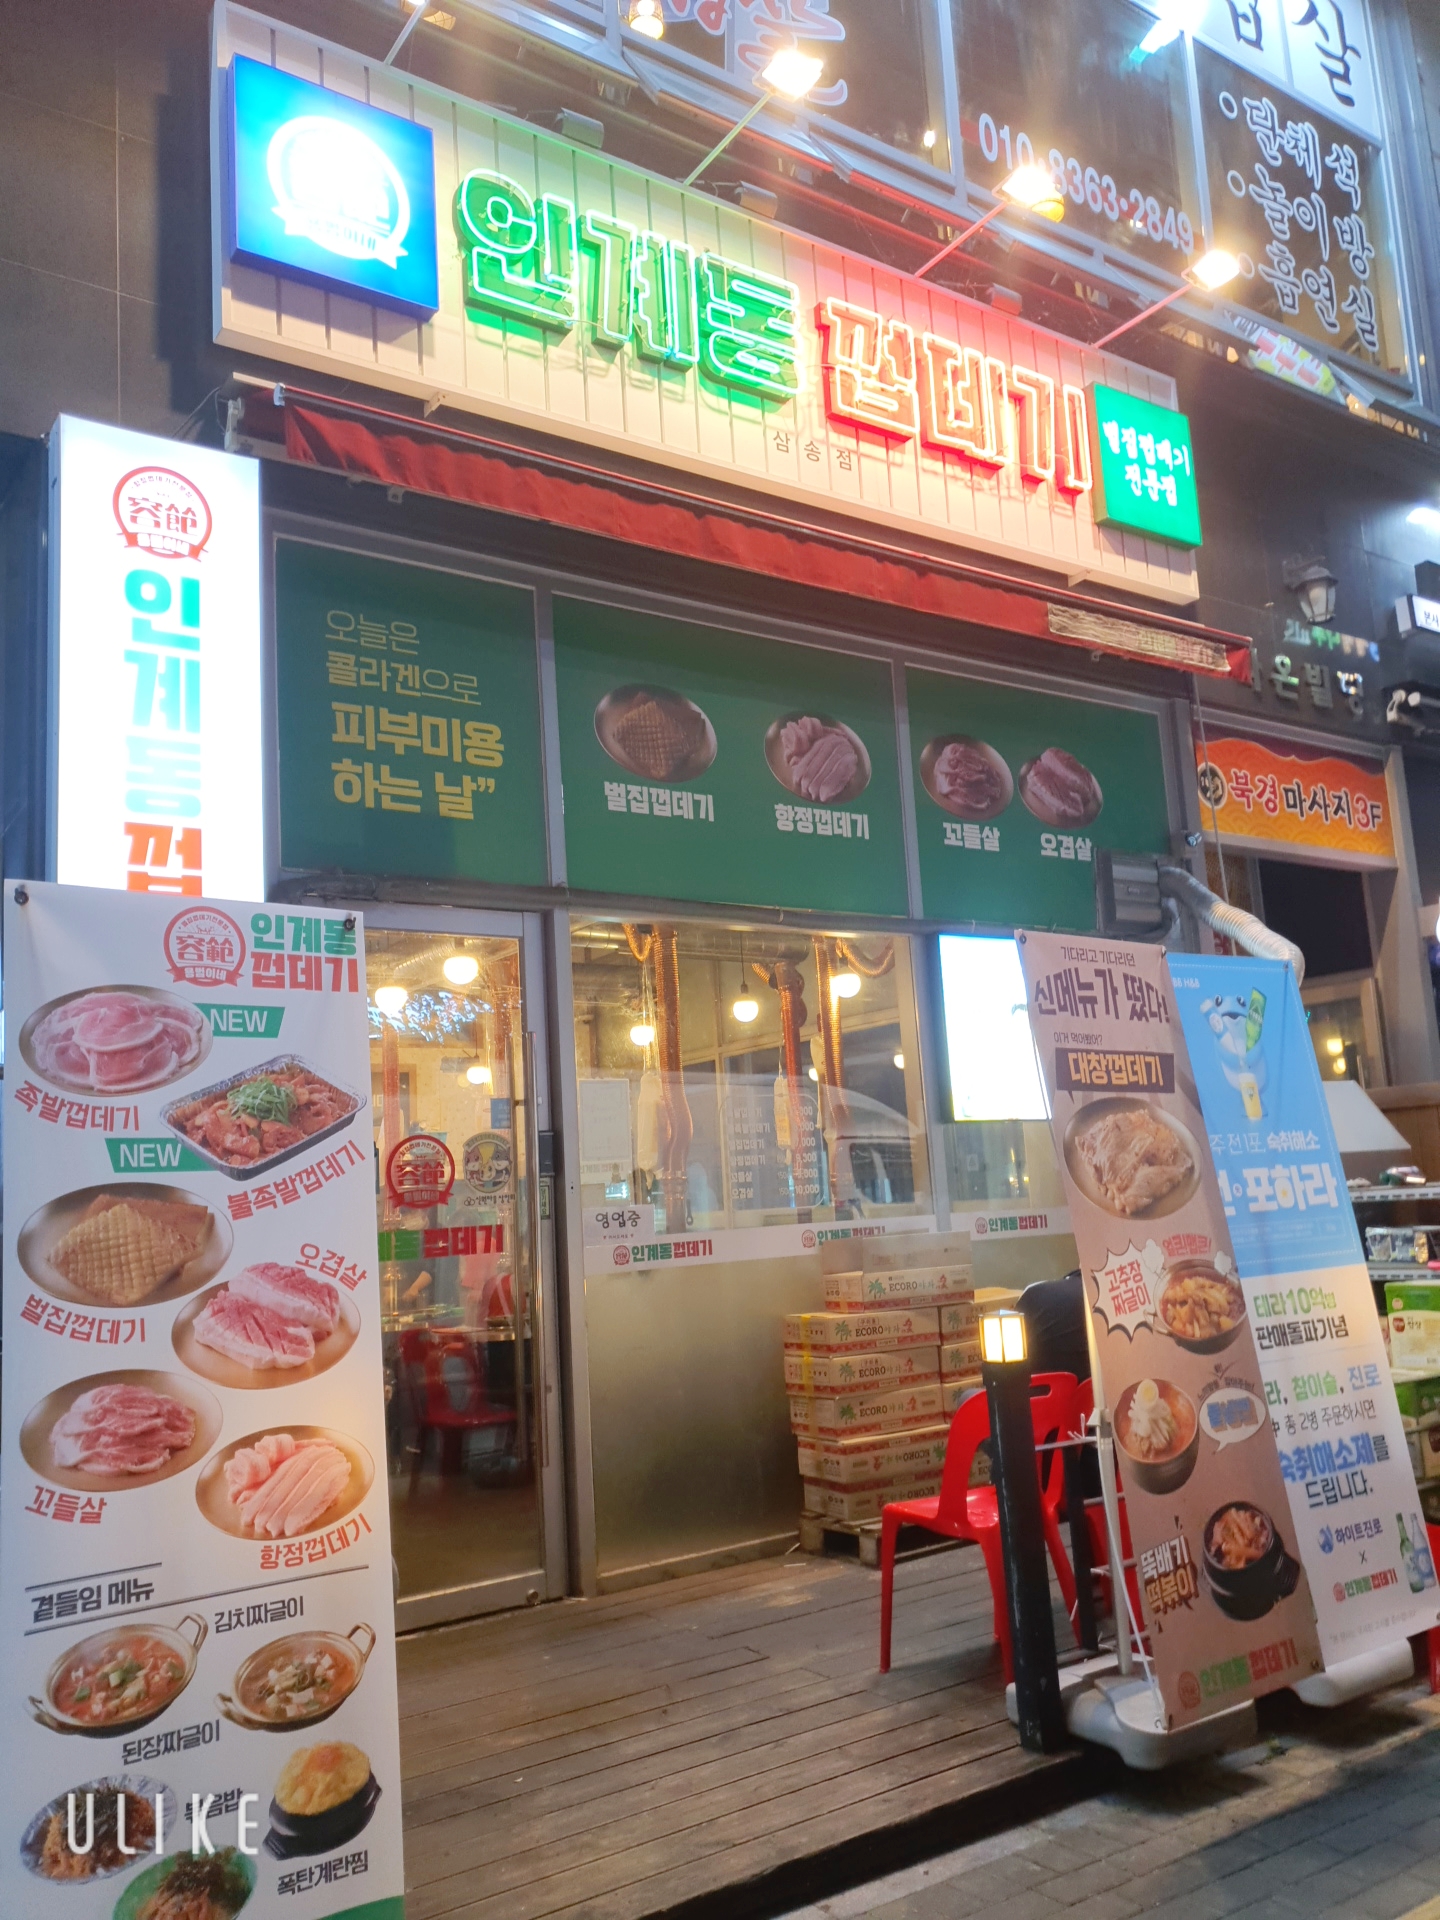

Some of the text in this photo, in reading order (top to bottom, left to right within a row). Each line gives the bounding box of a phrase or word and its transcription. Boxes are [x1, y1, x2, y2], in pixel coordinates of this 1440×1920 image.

[455, 168, 1093, 495] 인계동 껍데기
[773, 431, 854, 471] 삼송점
[325, 610, 420, 655] 오늘은
[326, 651, 482, 706] 콜라겐으로
[331, 701, 505, 768] 피부미용
[331, 758, 423, 814] 하는
[604, 781, 715, 823] 벌집껍데기
[774, 803, 870, 840] 항정껍데기
[943, 821, 1000, 852] 꼬들살
[1040, 832, 1093, 862] 오겹살
[250, 913, 357, 956] 인계동
[251, 951, 359, 993] 껍데기
[1060, 946, 1099, 964] 기다리고
[1035, 966, 1120, 1020] 신메뉴가
[210, 1008, 268, 1034] NEW
[1068, 1051, 1164, 1087] 대창껍데기
[14, 1080, 140, 1132] 족발껍데기
[119, 1143, 182, 1168] NEW
[227, 1140, 366, 1221] 불족발껍데기
[595, 1210, 642, 1229] 영업중
[295, 1242, 367, 1291] 오겹살
[1105, 1259, 1142, 1294] 고추장
[889, 1281, 918, 1293] ECORO
[1110, 1282, 1152, 1317] 짜글이
[20, 1293, 146, 1345] 벌집껍데기
[855, 1325, 884, 1338] ECORO
[1255, 1313, 1350, 1350] 판매돌파기념
[858, 1365, 886, 1379] ECORO
[1290, 1370, 1345, 1404] 참이슬,
[1347, 1363, 1382, 1391] 진로
[859, 1404, 888, 1418] ECORO
[1284, 1414, 1297, 1436] 총
[1300, 1410, 1319, 1432] 2병
[1321, 1398, 1377, 1428] 주문하시면
[1278, 1431, 1390, 1484] 숙취해소제를
[25, 1485, 107, 1524] 꼬들살
[1304, 1469, 1374, 1509] 드립니다.
[260, 1513, 372, 1570] 항정껍데기
[1335, 1518, 1384, 1545] 하이트진로
[1141, 1534, 1190, 1580] 뚝배기
[32, 1578, 155, 1623] 곁들임 메뉴
[214, 1596, 304, 1633] 김치짜글이
[121, 1719, 220, 1765] 된장짜글이
[277, 1850, 369, 1896] 폭탄계란찜
